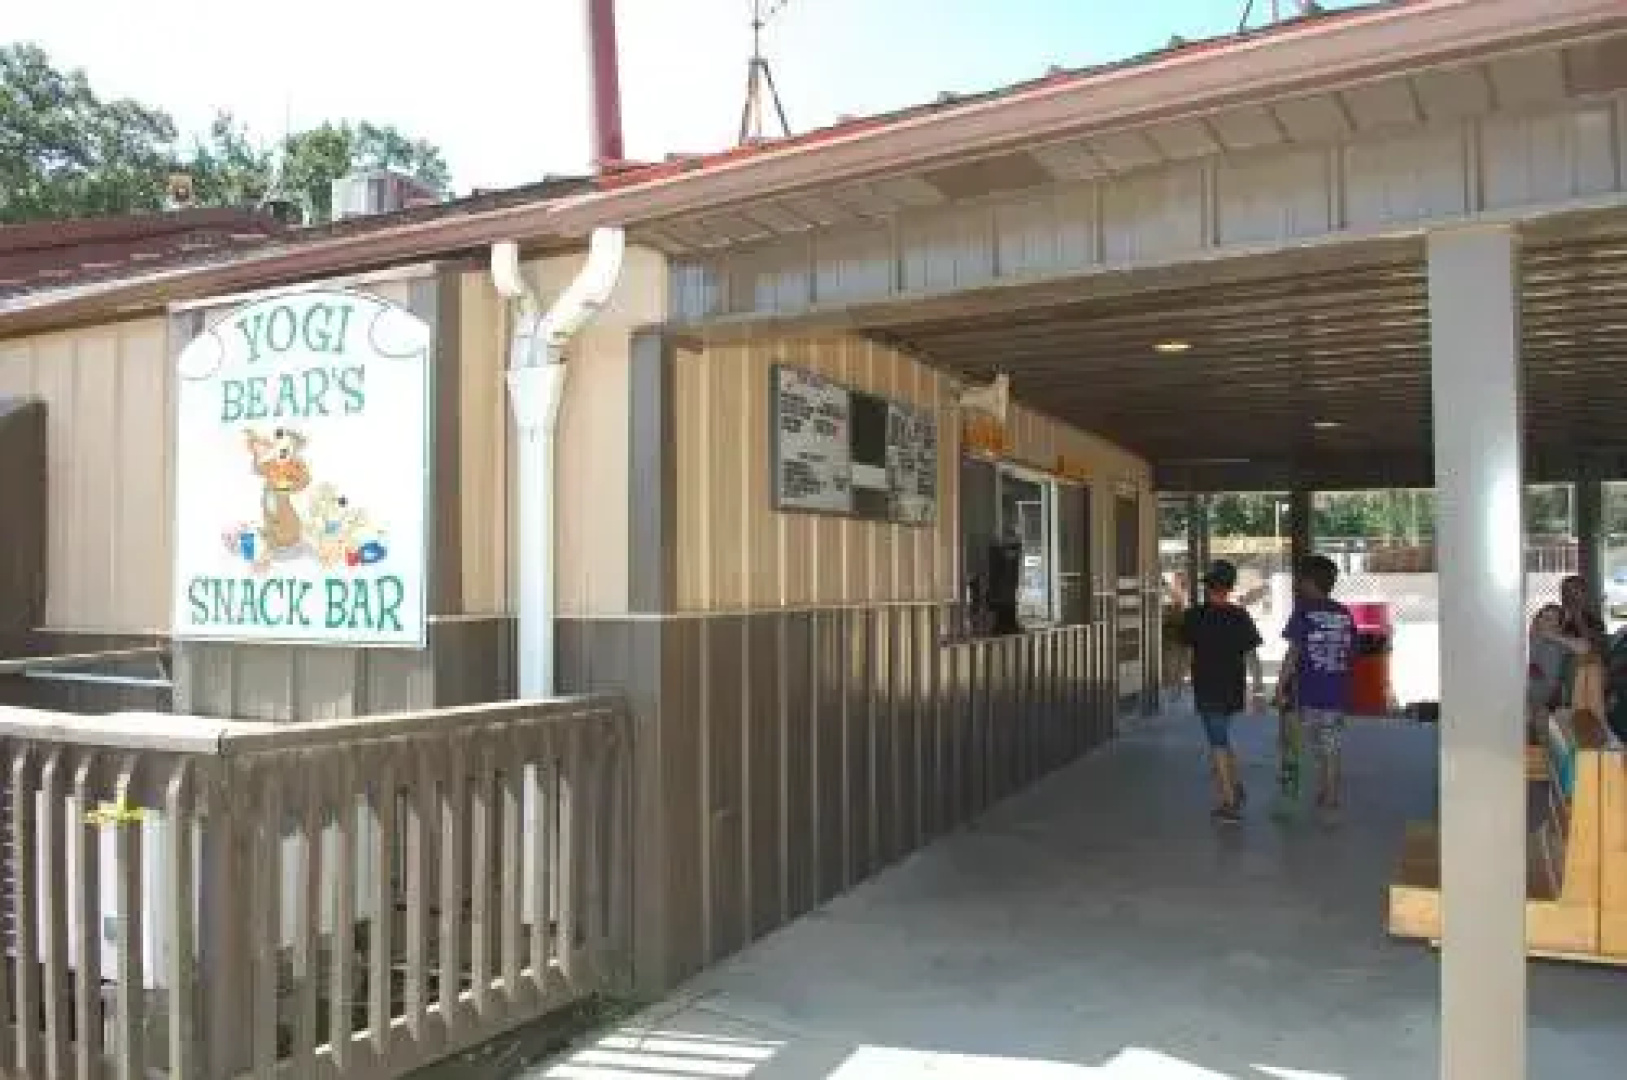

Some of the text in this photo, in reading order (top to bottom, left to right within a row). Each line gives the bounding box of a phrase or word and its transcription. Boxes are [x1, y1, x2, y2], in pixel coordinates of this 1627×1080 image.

[235, 302, 353, 361] YOGI
[221, 364, 366, 422] BEAR'S
[188, 575, 404, 631] SNACK BAR
